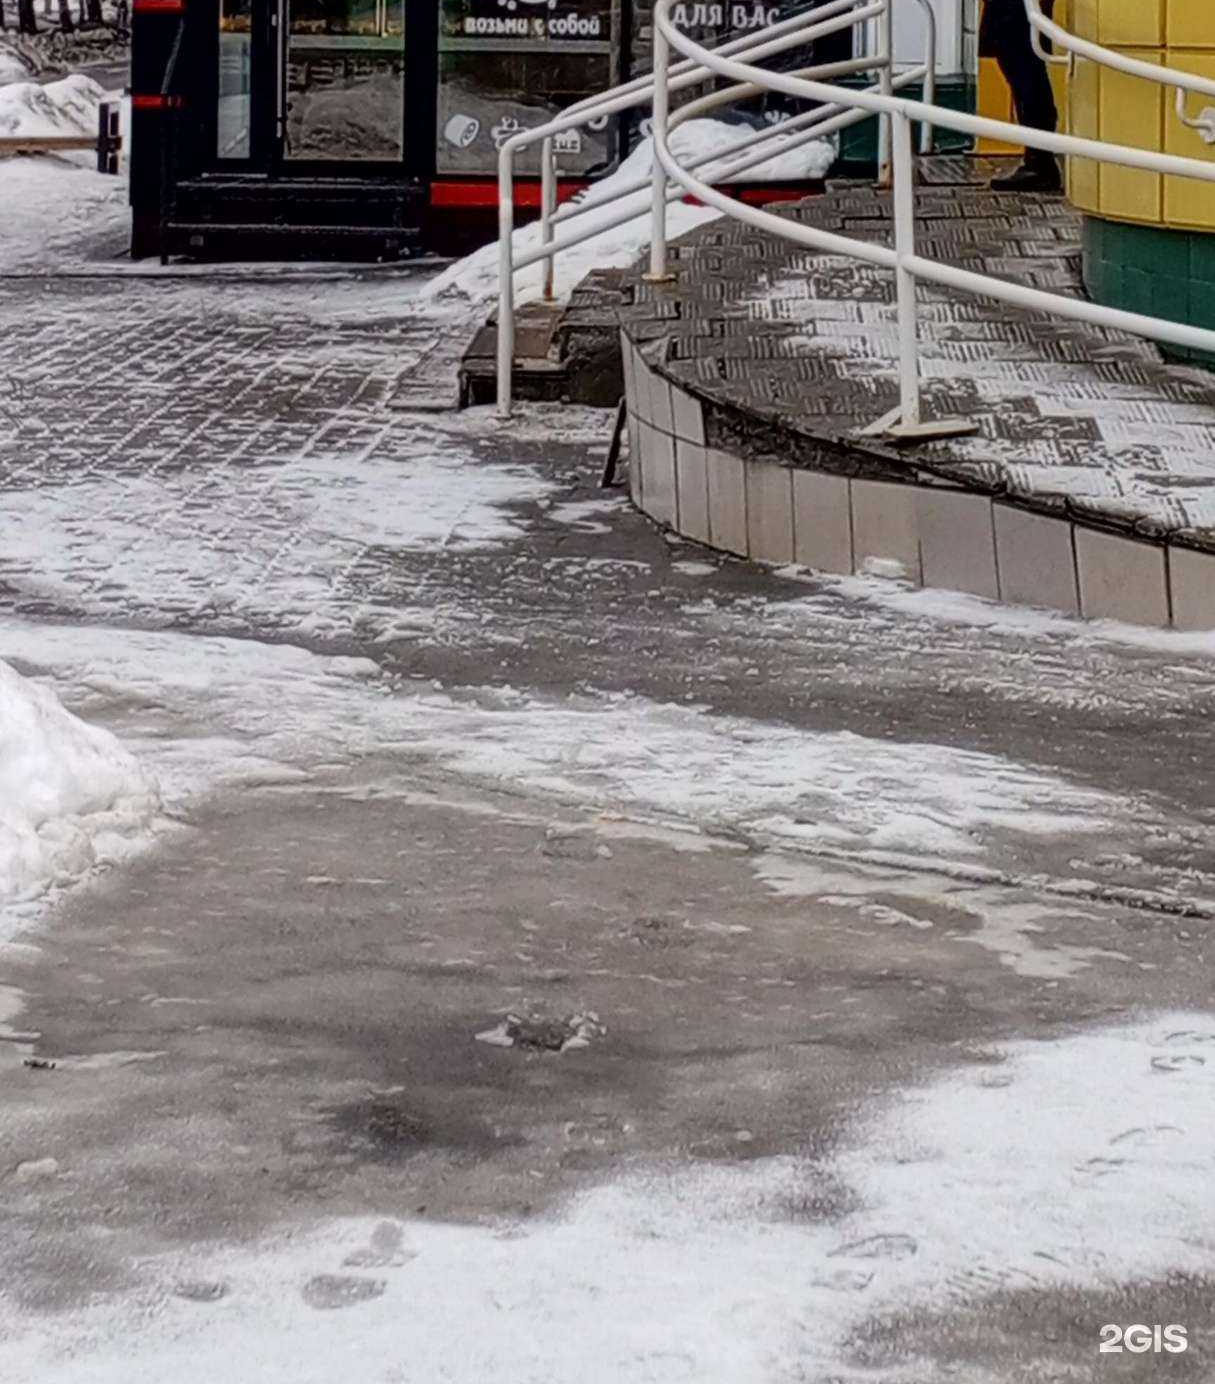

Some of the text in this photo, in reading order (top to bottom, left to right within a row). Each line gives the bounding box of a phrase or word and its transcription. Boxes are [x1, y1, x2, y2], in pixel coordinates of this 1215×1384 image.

[465, 17, 528, 34] возьми
[549, 13, 600, 34] собой
[672, 4, 722, 28] ДЛЯ
